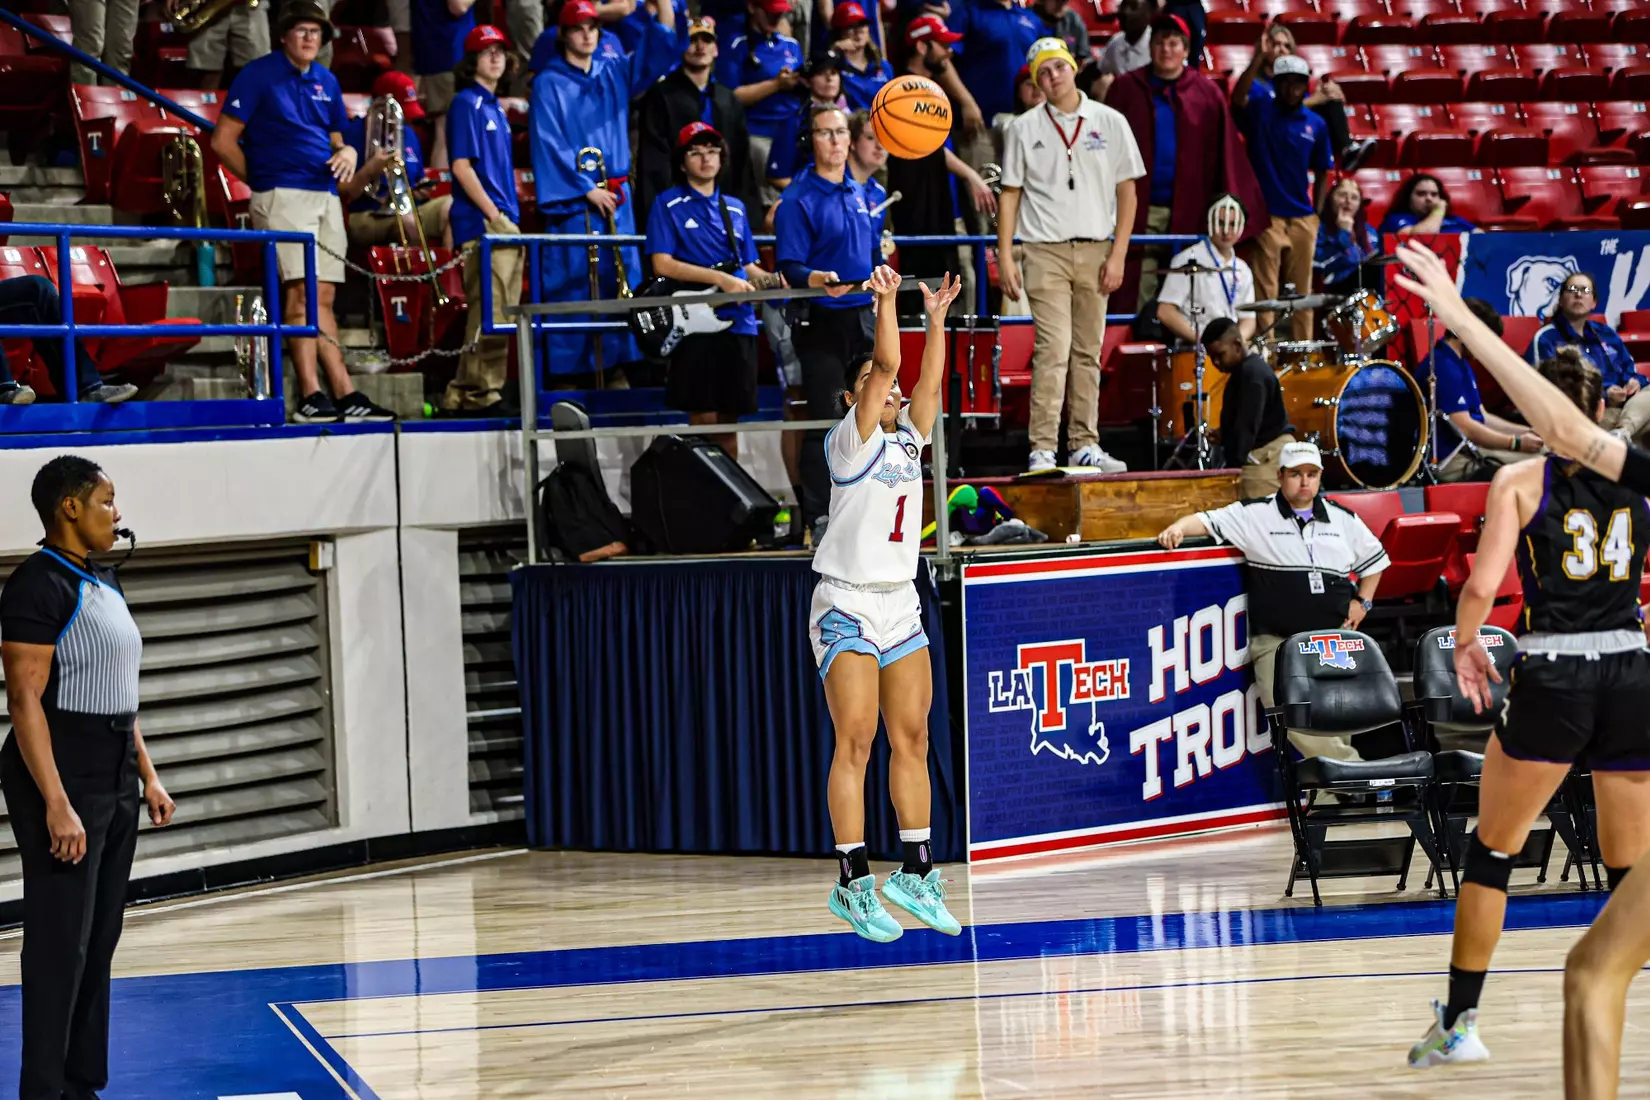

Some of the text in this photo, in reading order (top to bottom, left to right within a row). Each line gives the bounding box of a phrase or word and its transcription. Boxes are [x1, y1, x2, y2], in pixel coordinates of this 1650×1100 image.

[914, 101, 948, 120] NCAA
[1600, 238, 1620, 256] THE
[888, 495, 907, 542] 1
[1562, 508, 1635, 582] 34
[1148, 592, 1249, 704] HOO
[1299, 633, 1364, 659] LA TECH
[988, 638, 1130, 732] LA TECH
[1129, 683, 1272, 802] TROO
